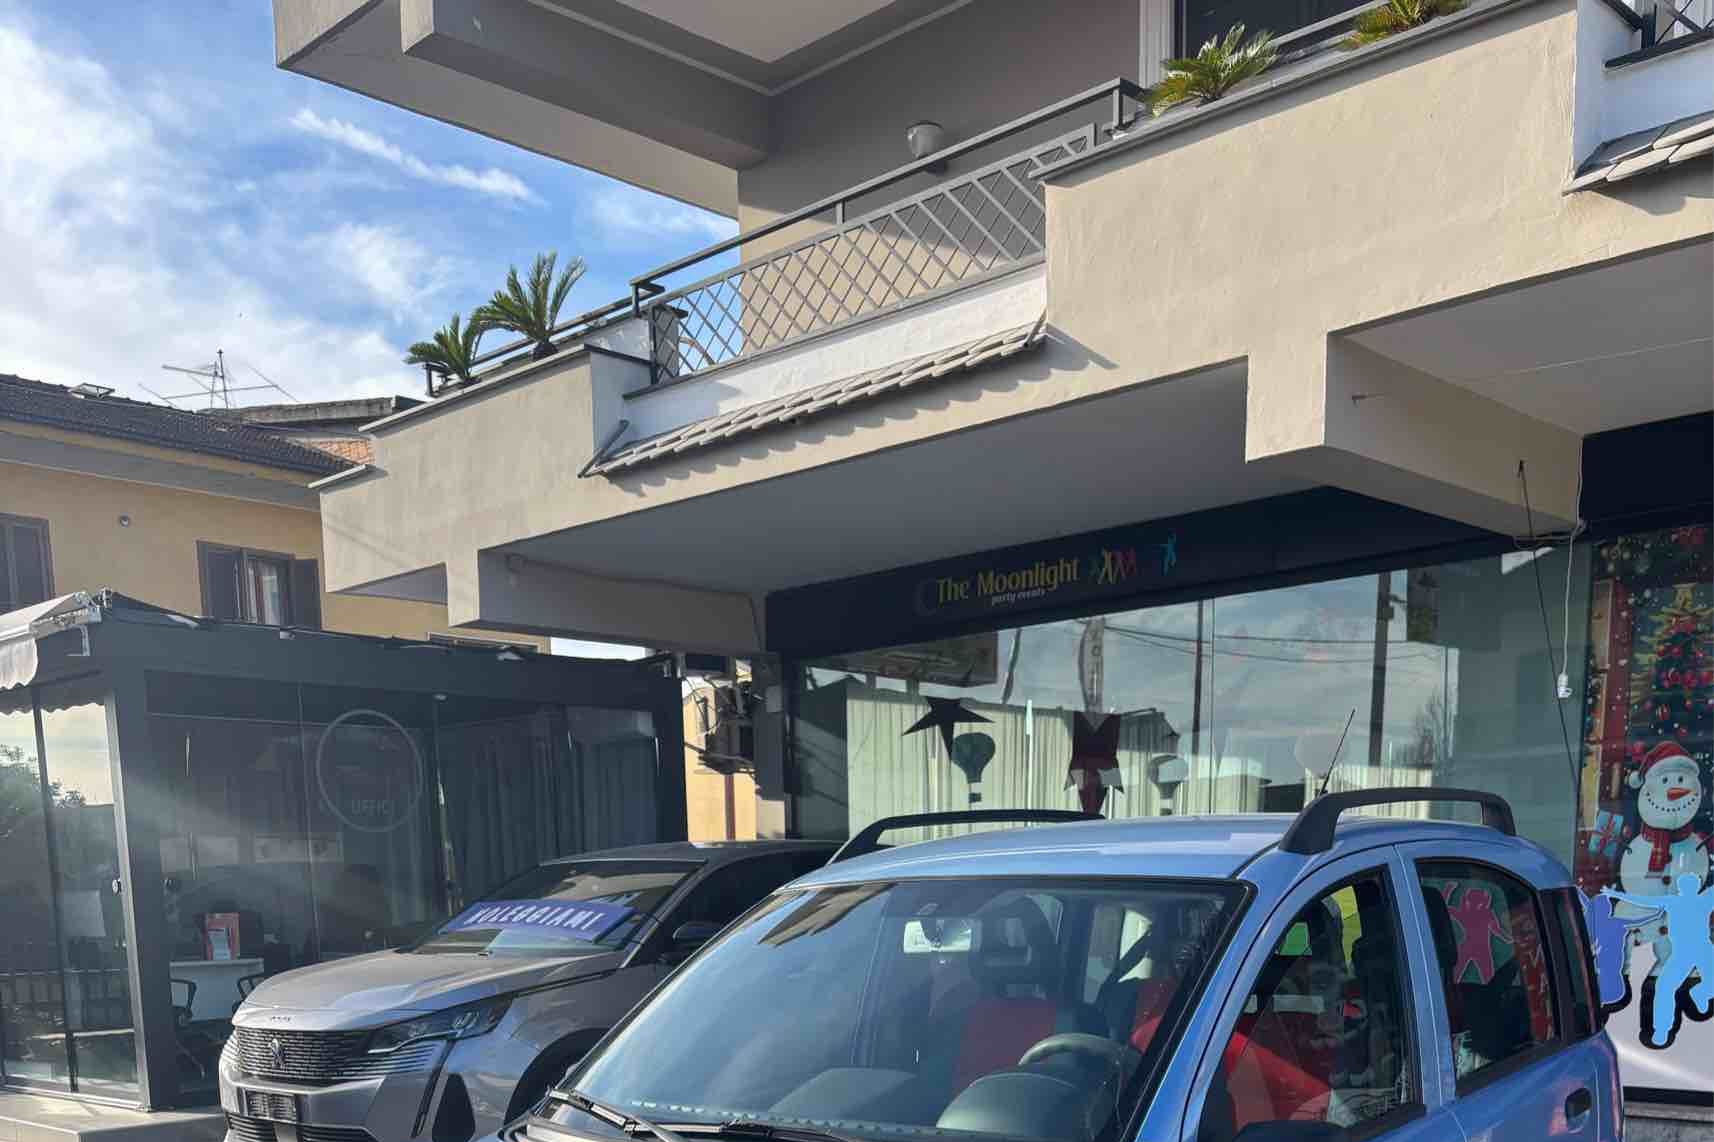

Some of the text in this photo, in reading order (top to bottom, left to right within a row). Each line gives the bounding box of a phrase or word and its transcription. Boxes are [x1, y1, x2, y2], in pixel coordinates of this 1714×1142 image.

[936, 557, 1079, 608] The Moonlight
[991, 594, 1016, 607] party
